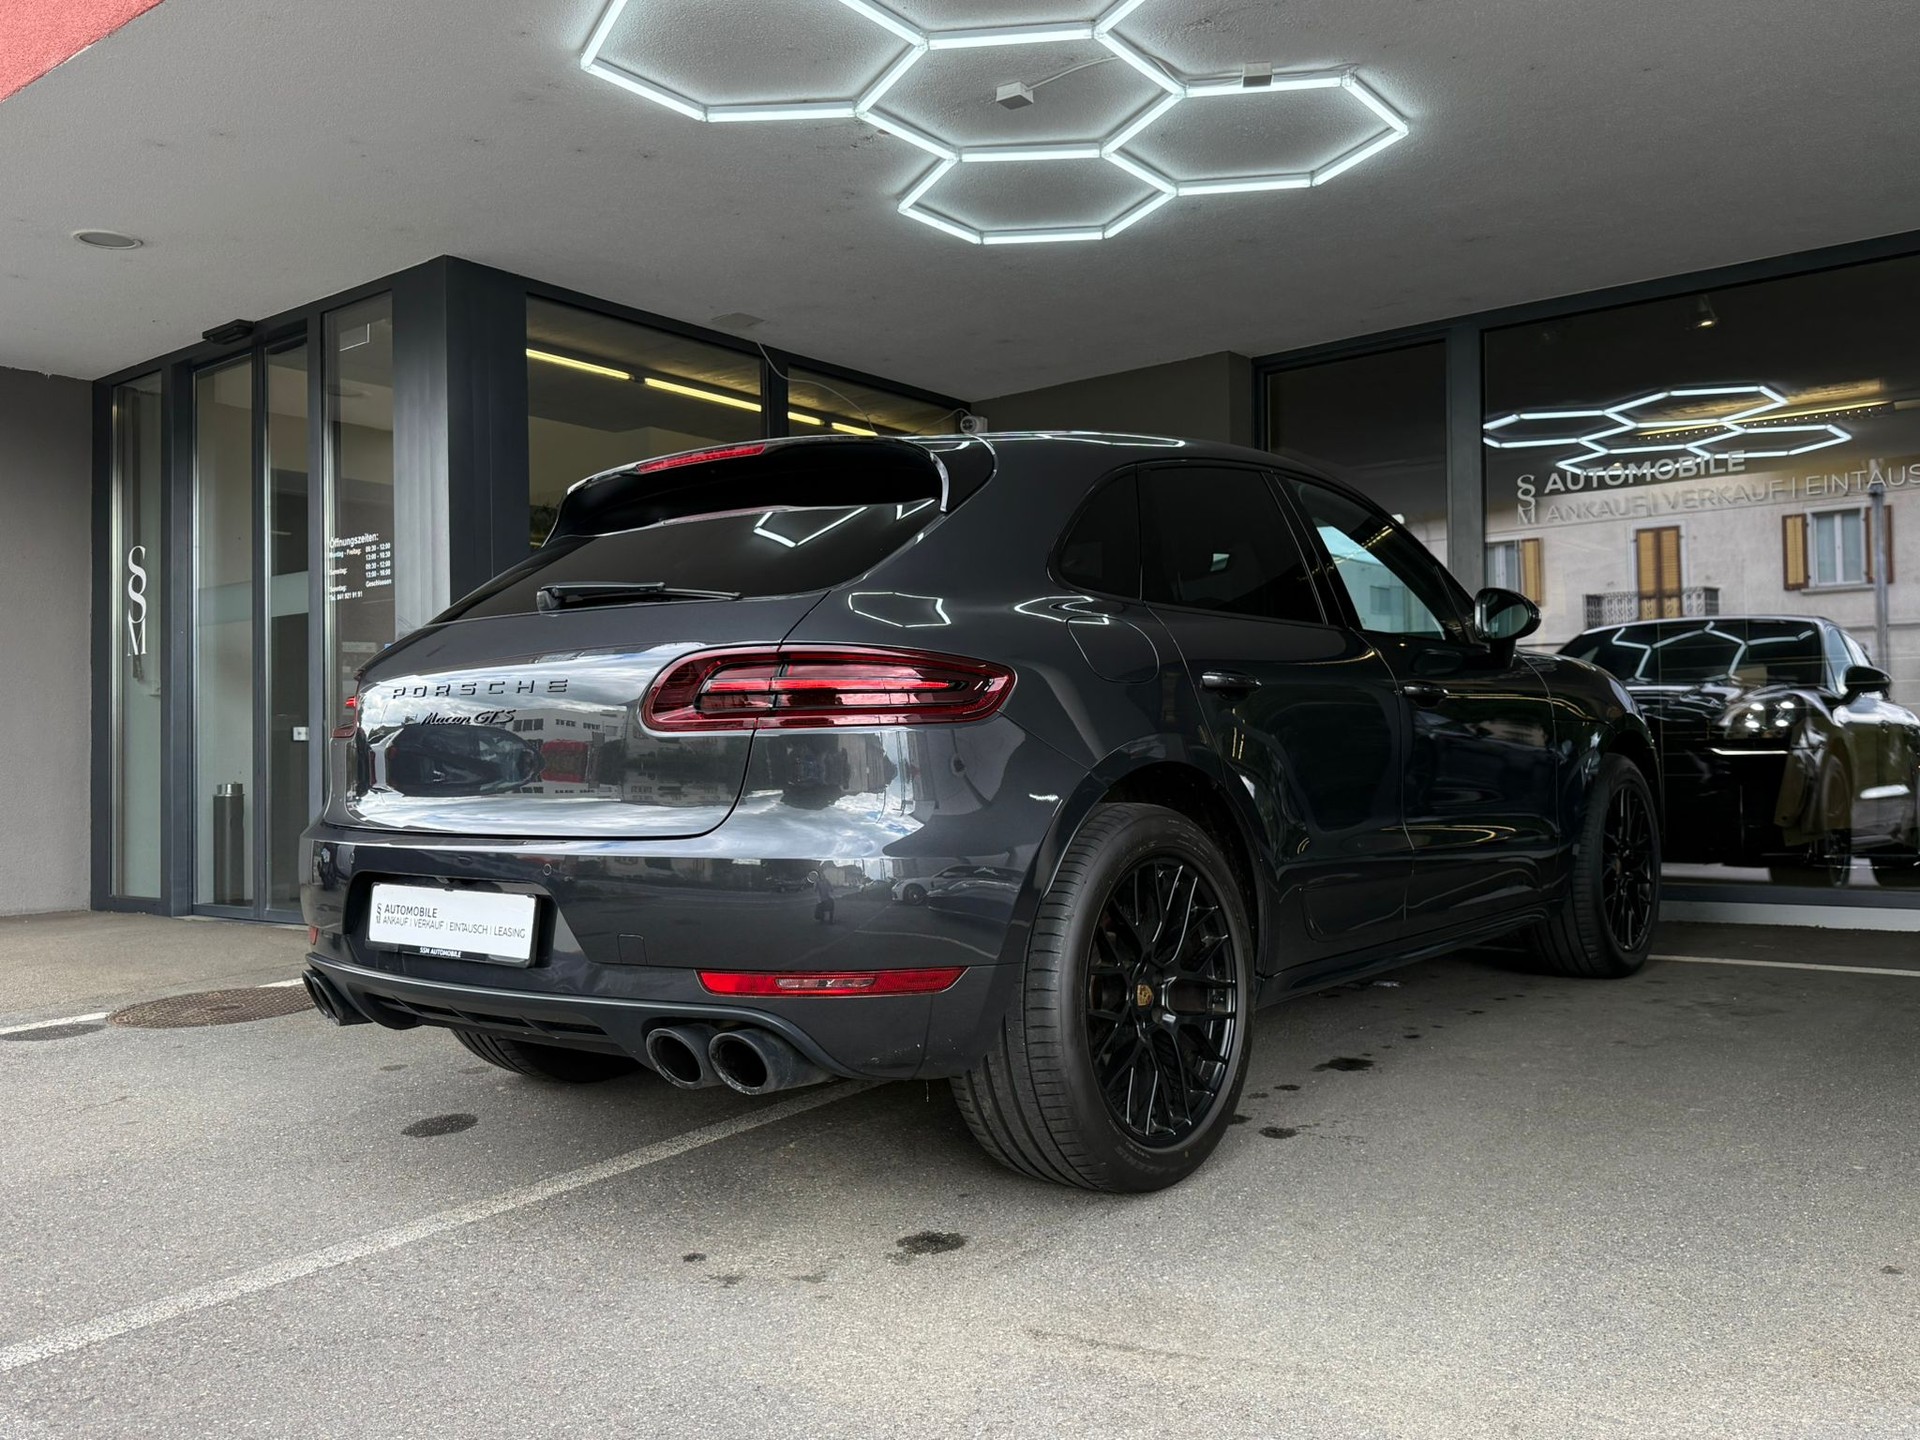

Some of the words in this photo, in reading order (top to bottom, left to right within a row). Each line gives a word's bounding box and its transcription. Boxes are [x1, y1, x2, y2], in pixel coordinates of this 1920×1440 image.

[1543, 449, 1747, 495] AUTOMOBILE
[1547, 494, 1649, 525] ANKAUF
[1663, 479, 1784, 512] VERKAUF
[392, 678, 569, 700] PORSCHE
[419, 711, 472, 726] Macan
[472, 709, 517, 725] GTS
[384, 903, 438, 919] AUTOMOBILE
[382, 914, 410, 927] ANKAUF
[413, 918, 445, 931] VERKAUF
[449, 921, 489, 935] EINTAUSCH
[493, 925, 526, 939] LEASING
